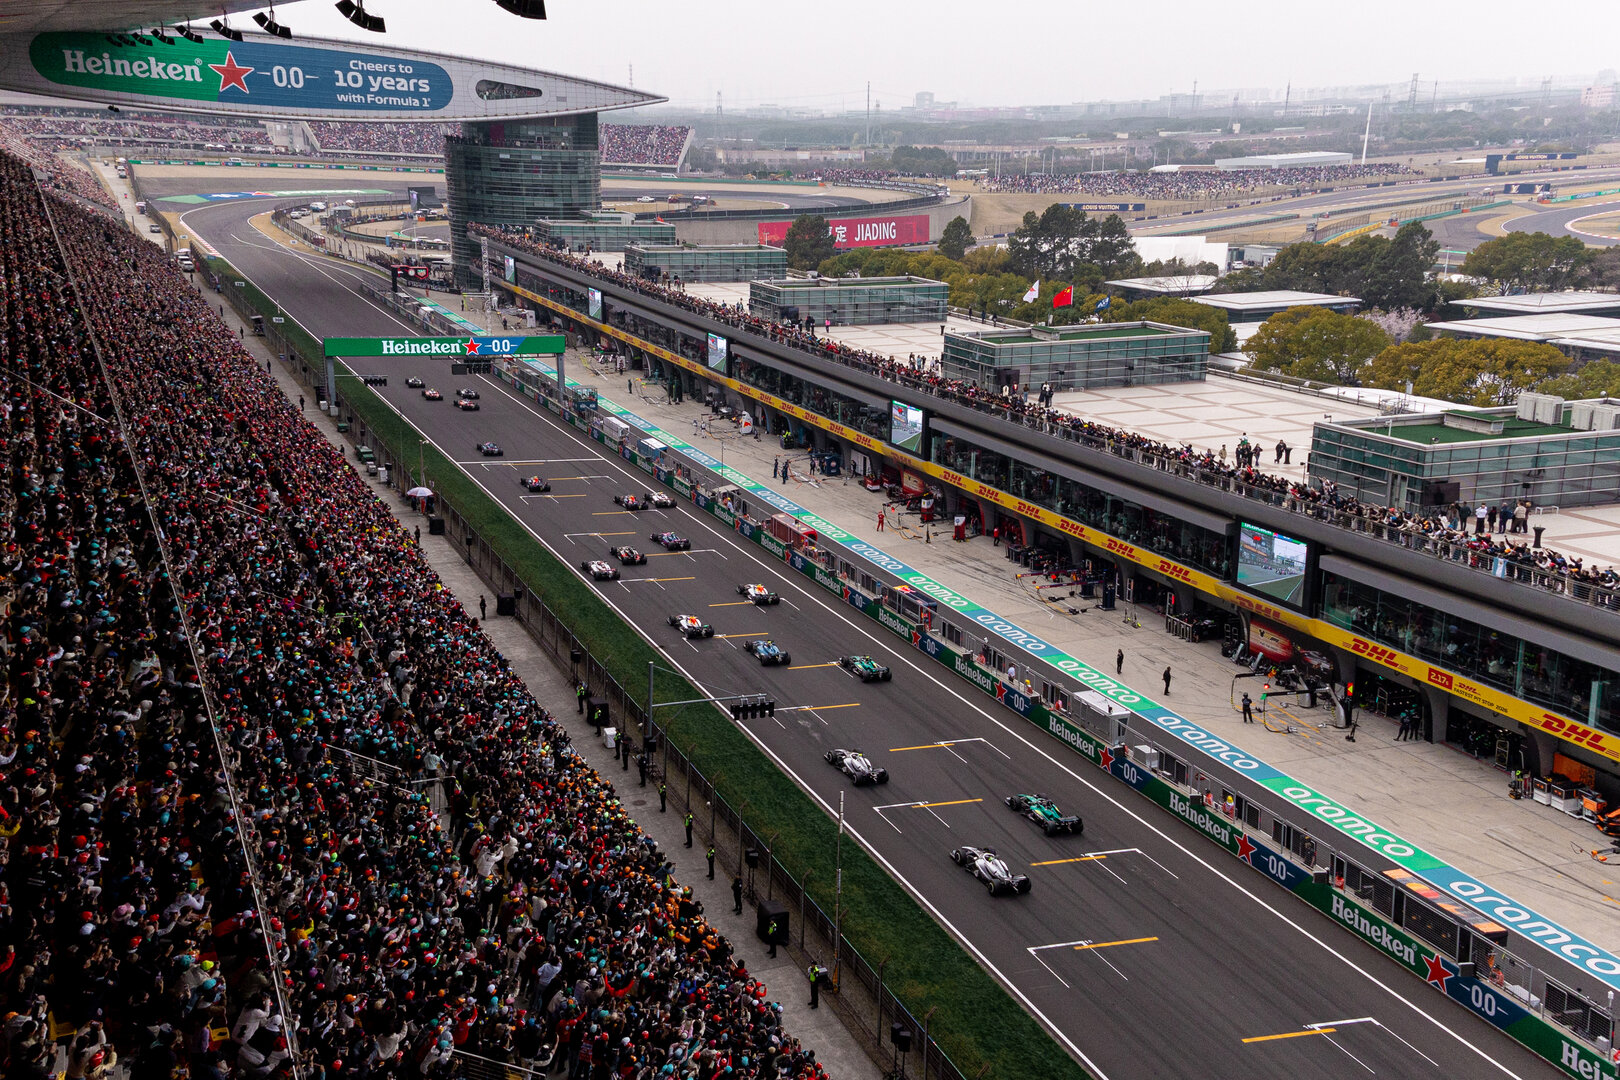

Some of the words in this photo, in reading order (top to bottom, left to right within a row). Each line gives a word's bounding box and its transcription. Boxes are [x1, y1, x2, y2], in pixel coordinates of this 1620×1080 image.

[350, 60, 395, 73] Cheers
[398, 63, 413, 74] to
[334, 69, 363, 88] 10
[367, 75, 430, 92] years
[337, 93, 365, 104] with
[366, 94, 420, 107] Formula
[855, 221, 897, 242] JIADING
[738, 384, 751, 395] DHL
[759, 392, 772, 404] DHL
[781, 402, 795, 414] DHL
[804, 411, 818, 424] DHL
[829, 422, 845, 435] DHL
[855, 433, 873, 447] DHL
[943, 470, 963, 486] DHL
[757, 490, 799, 511] aramco
[979, 486, 1000, 502] DHL
[1017, 501, 1041, 519] DHL
[802, 515, 848, 538] aramco
[1059, 519, 1086, 538] DHL
[852, 543, 903, 570] aramco
[1107, 538, 1136, 559] DHL
[815, 567, 842, 595] Heineken
[1159, 560, 1192, 582] DHL
[909, 575, 969, 607] aramco
[1237, 595, 1281, 619] DHL
[878, 607, 910, 638] Heineken
[977, 614, 1046, 651] aramco
[1350, 638, 1401, 668] DHL
[955, 656, 992, 691] Heineken
[1057, 660, 1141, 704] aramco
[1454, 687, 1473, 699] FASTEST
[1473, 695, 1481, 703] PIT
[1482, 699, 1494, 707] STOP
[1458, 682, 1477, 694] DHL
[1049, 716, 1095, 758] Heineken
[1157, 716, 1260, 770] aramco
[1541, 713, 1607, 753] DHL
[1169, 791, 1230, 845] Heineken
[1283, 787, 1415, 857] aramco
[1268, 855, 1287, 880] 0.0
[1449, 881, 1620, 976] aramco
[1471, 984, 1497, 1017] 0.0
